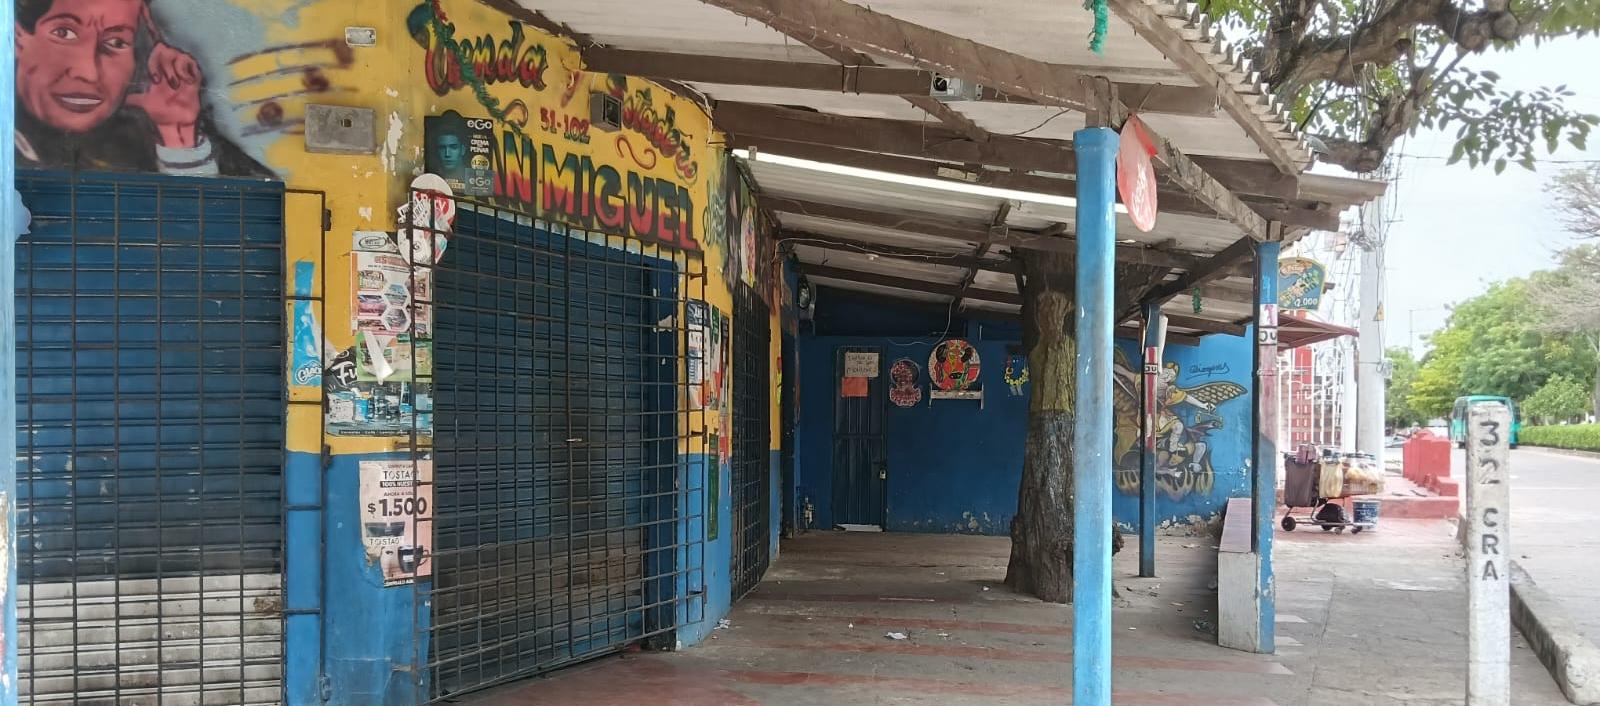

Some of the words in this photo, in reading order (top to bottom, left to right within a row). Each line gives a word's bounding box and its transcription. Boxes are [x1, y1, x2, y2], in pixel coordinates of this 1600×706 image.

[467, 119, 492, 130] eGo
[542, 143, 702, 257] MIGUEL
[379, 497, 428, 517] 1.500
[1481, 507, 1500, 581] CRA
